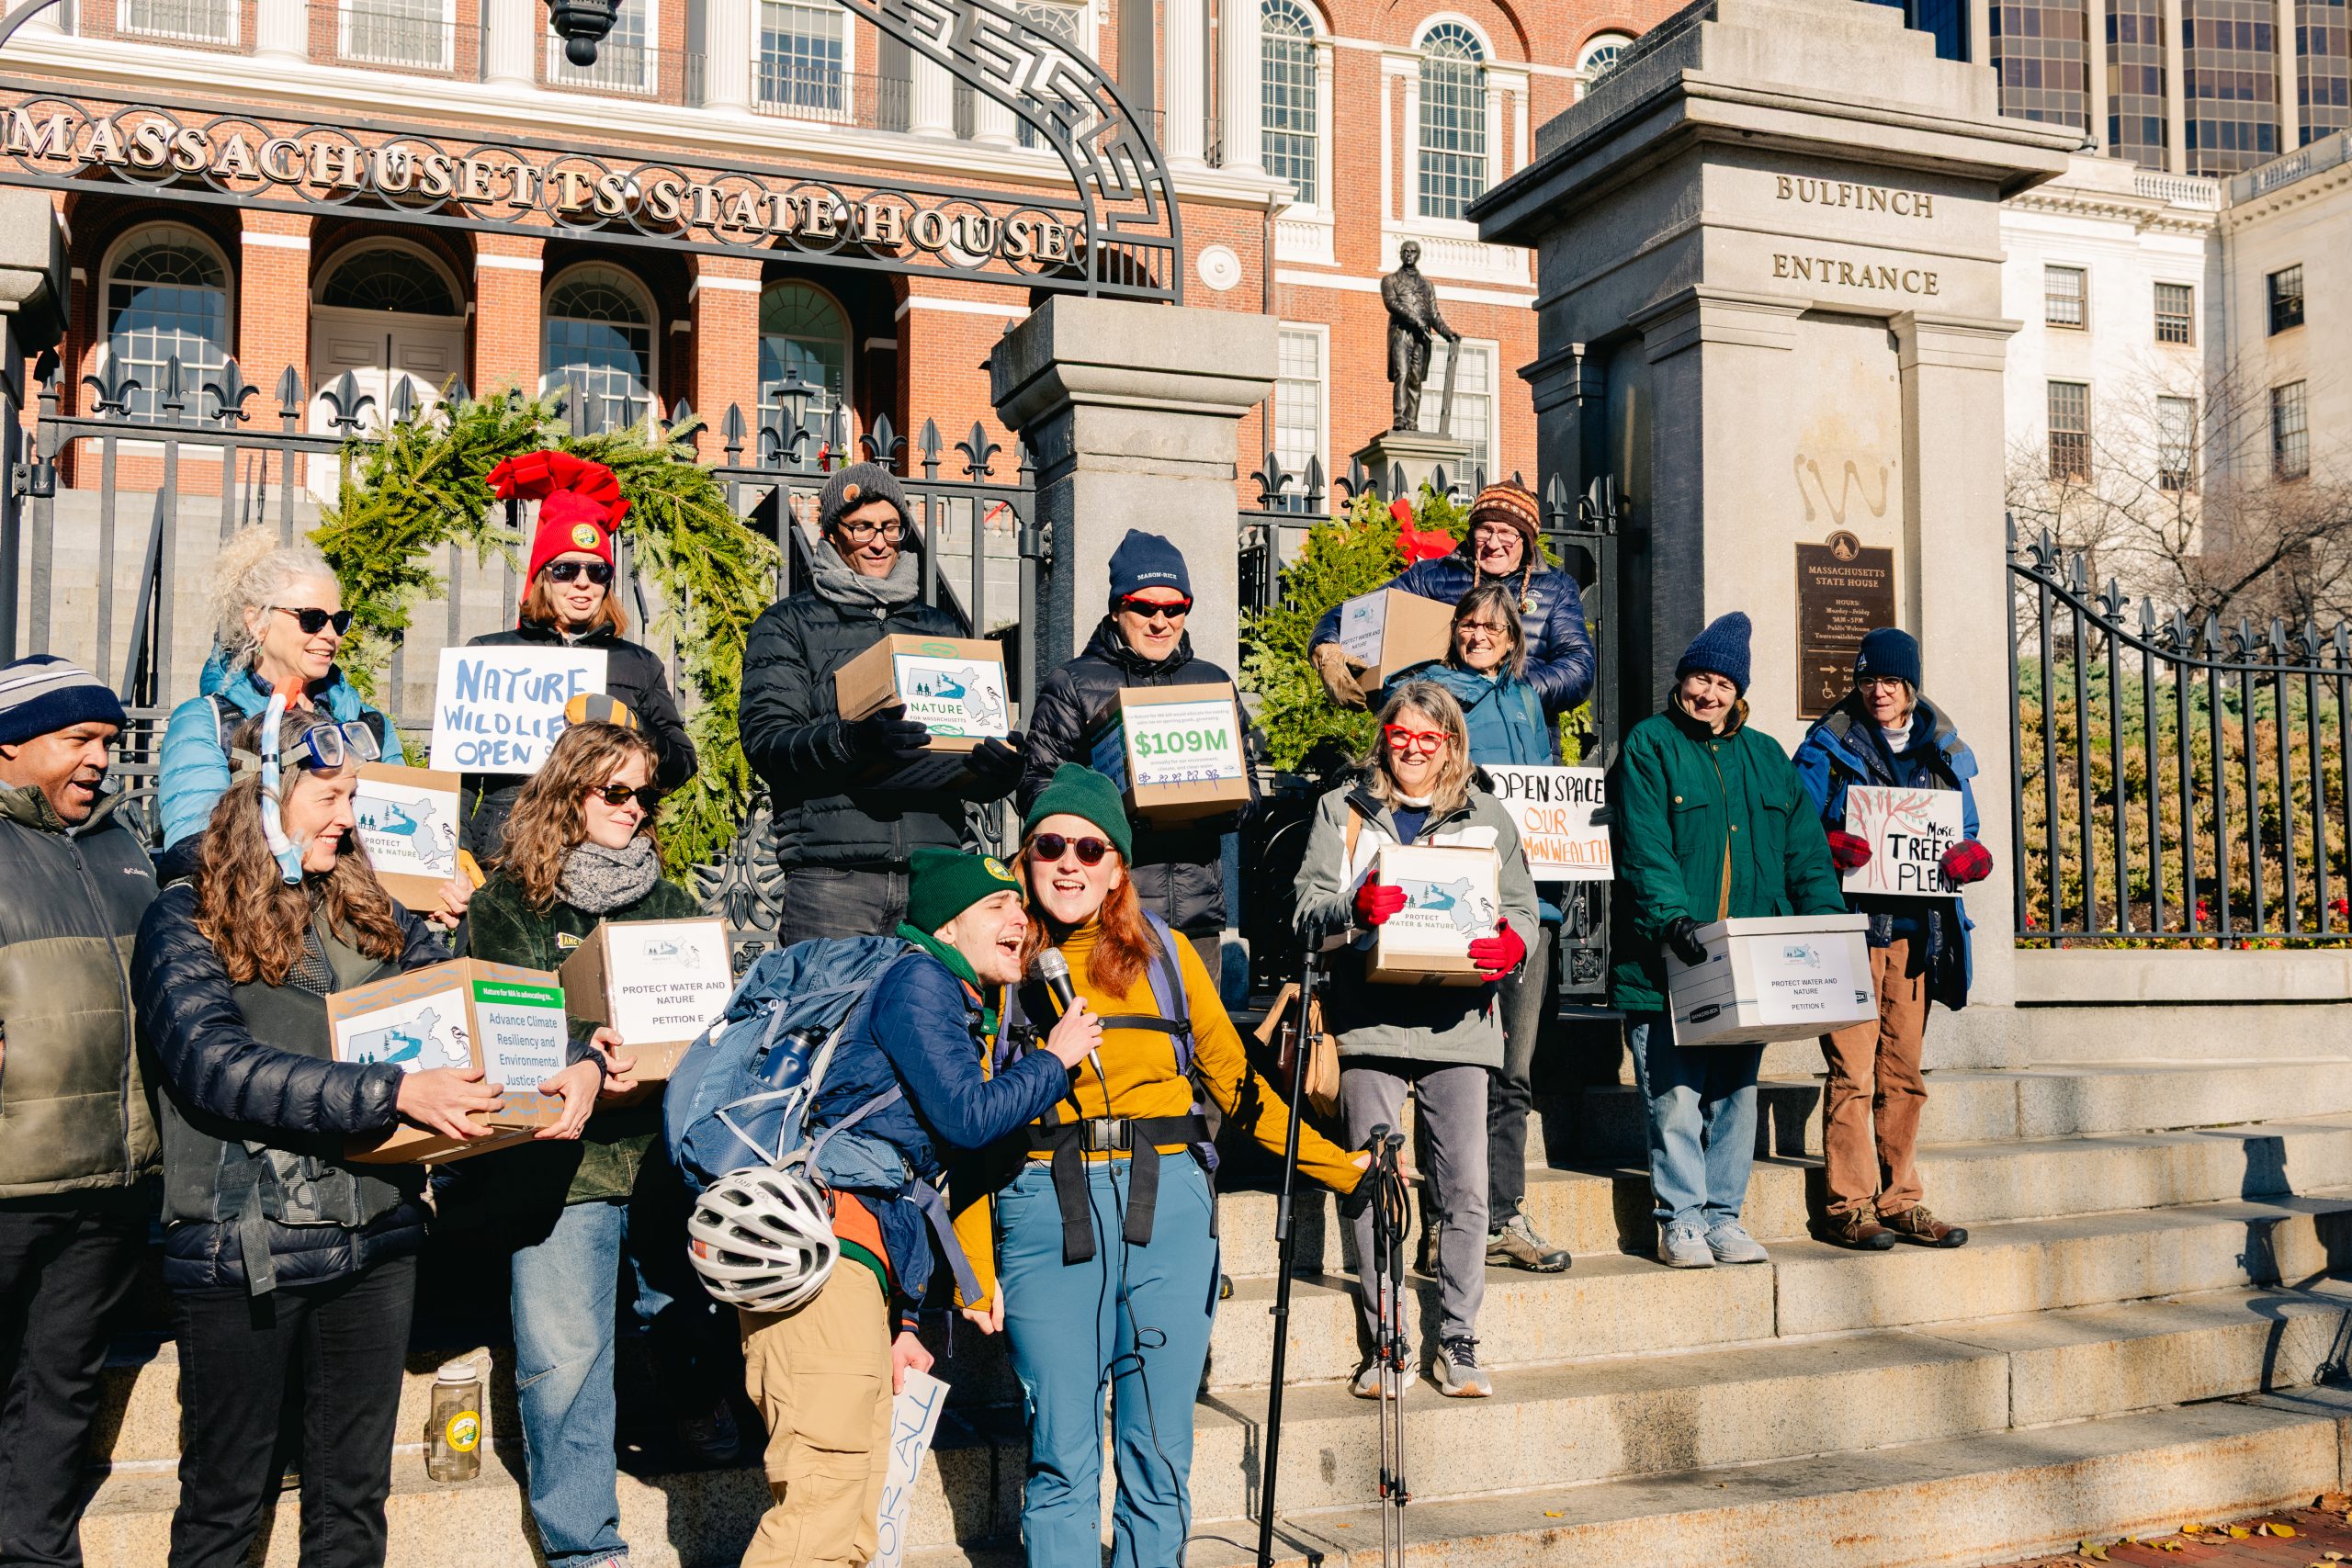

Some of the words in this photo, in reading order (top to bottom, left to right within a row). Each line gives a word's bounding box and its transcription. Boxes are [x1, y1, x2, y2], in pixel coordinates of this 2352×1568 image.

[8, 107, 625, 219] MASSACHUSETTS
[650, 180, 837, 241] STATE
[862, 201, 1069, 264] HOUSE
[1776, 175, 1934, 218] BULFINCH
[1772, 253, 1939, 296] ENTRANCE
[1808, 566, 1885, 578] MASSACHUSETTS
[1815, 577, 1845, 587] STATE
[1847, 578, 1879, 588] HOUSE
[456, 659, 589, 705] NATURE
[910, 702, 963, 715] NATURE
[444, 705, 564, 744] WILDLIF
[1134, 728, 1228, 758] $109M
[454, 739, 532, 767] OPEN
[1492, 773, 1549, 802] OPEN
[1555, 775, 1604, 806] SPACE
[1525, 807, 1568, 836] OUR
[1927, 822, 1955, 838] MORE
[365, 837, 401, 847] PROTECT
[386, 849, 417, 858] NATURE
[483, 987, 500, 996] Nature
[622, 985, 668, 994] PROTECT
[670, 982, 703, 992] WATER
[657, 995, 695, 1005] NATURE
[489, 1013, 525, 1026] Advance
[527, 1015, 558, 1029] Climate
[652, 1015, 696, 1025] PETITION
[497, 1033, 538, 1049] Resiliency
[540, 1036, 555, 1048] and
[499, 1054, 559, 1067] Environmental
[505, 1074, 536, 1086] Justice
